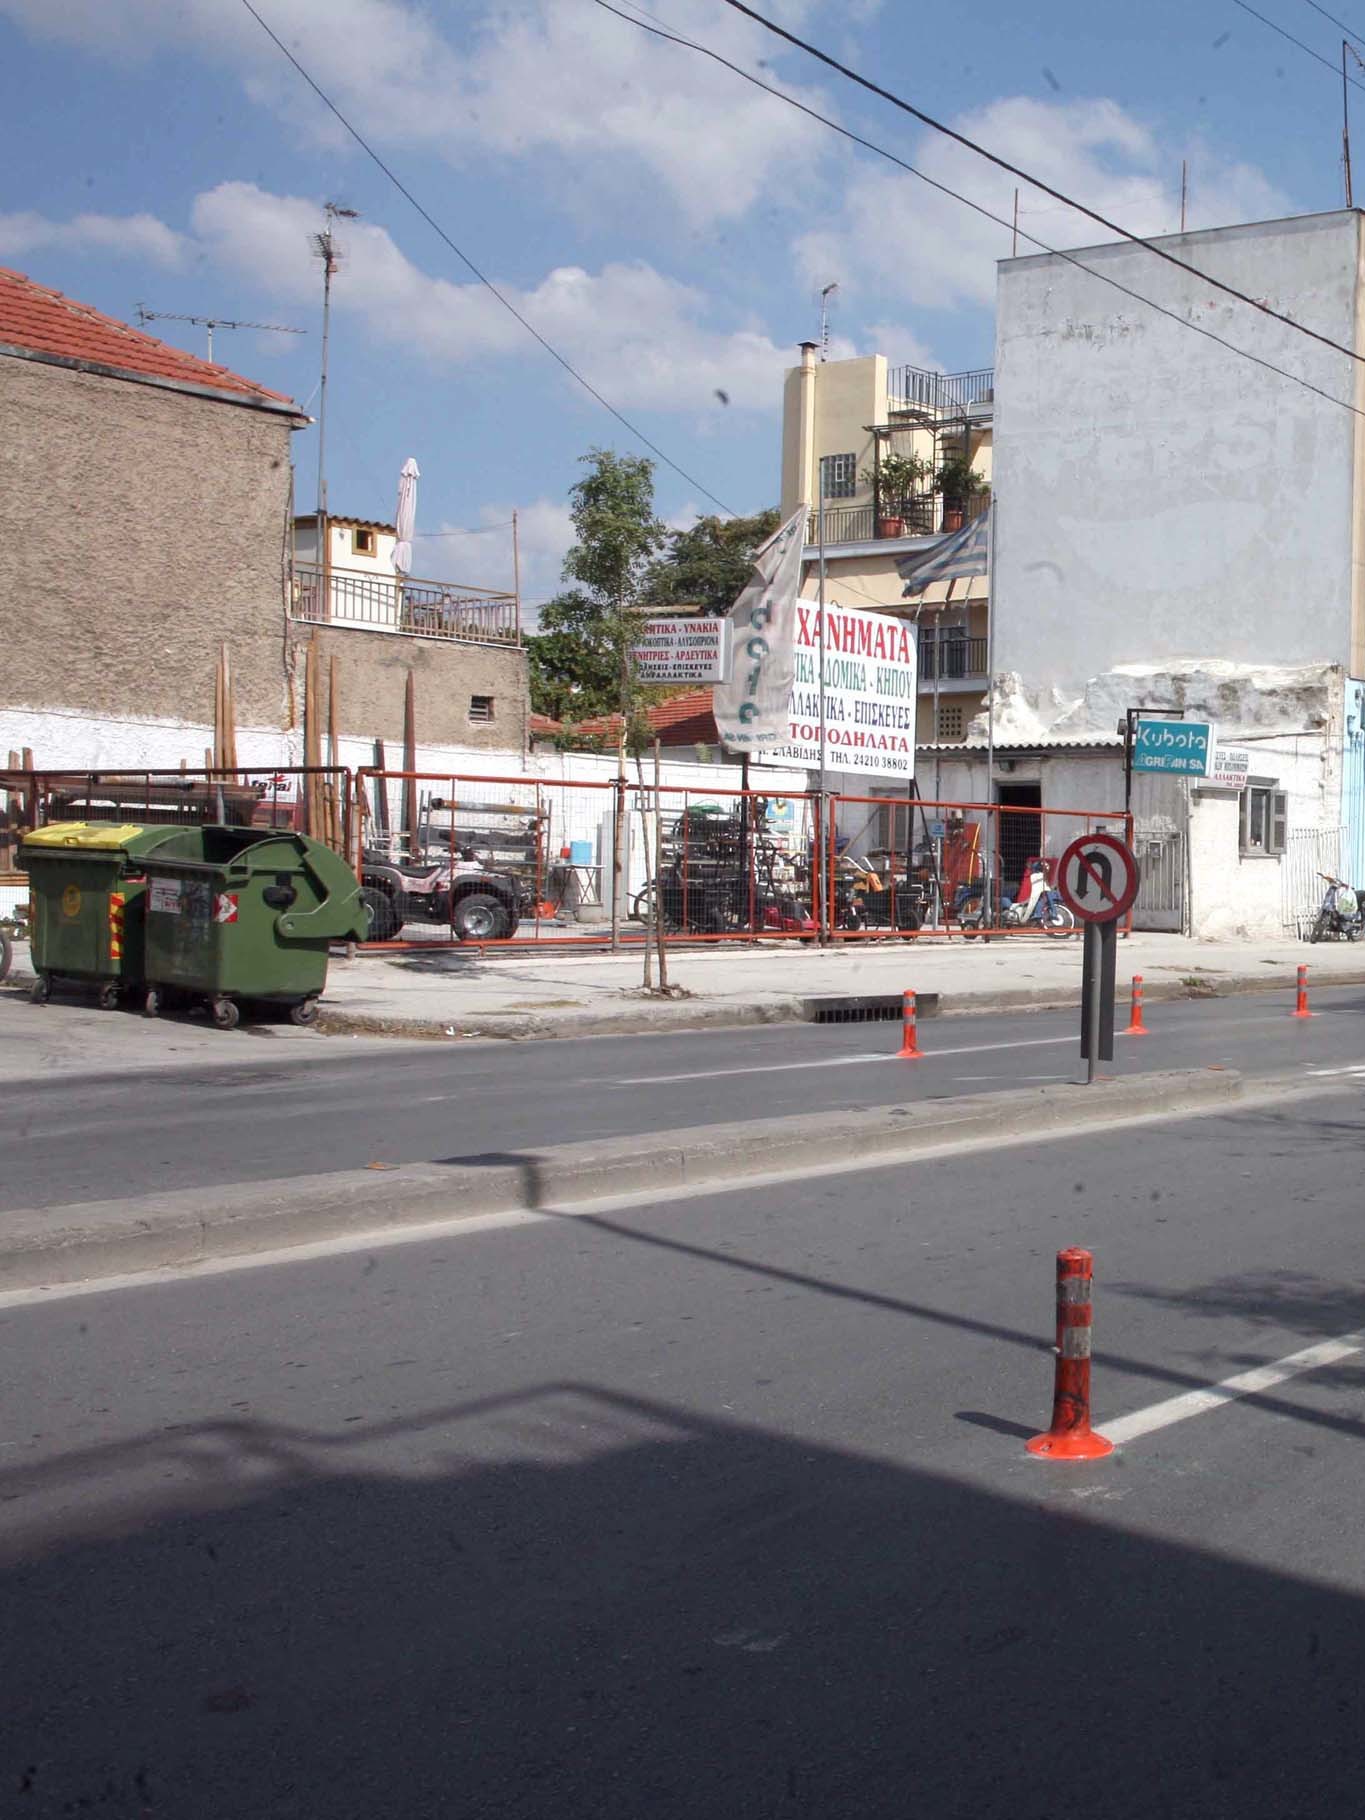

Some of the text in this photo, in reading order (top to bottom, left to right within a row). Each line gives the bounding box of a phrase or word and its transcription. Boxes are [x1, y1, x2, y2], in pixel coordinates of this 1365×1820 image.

[797, 607, 910, 664] ΧΑΝΗΜΑΤΑ
[876, 666, 913, 699] ΚΗΠΟΥ
[854, 700, 911, 730] ΕΠΙΣΚΕΥΕΣ
[788, 722, 910, 753] ΤΟΠΟΔΗΛΑΤΑ
[1137, 725, 1207, 751] Kubota
[853, 754, 880, 767] 24210
[881, 757, 908, 770] 38802
